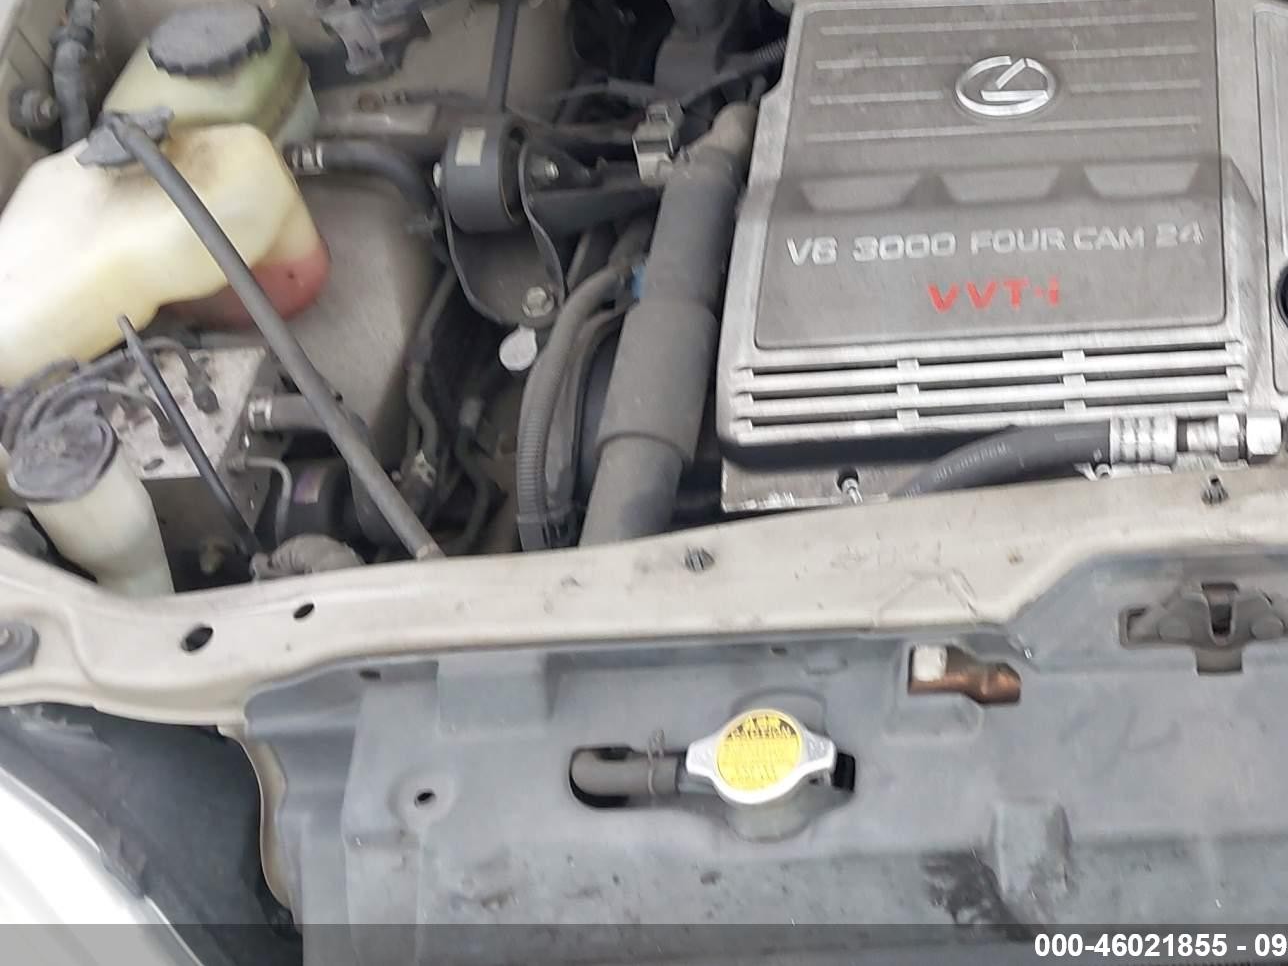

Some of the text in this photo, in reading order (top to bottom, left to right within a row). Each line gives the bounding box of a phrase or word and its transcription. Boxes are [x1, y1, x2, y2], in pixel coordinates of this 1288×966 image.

[786, 220, 1204, 266] V6 3000 FOUR CAM 24
